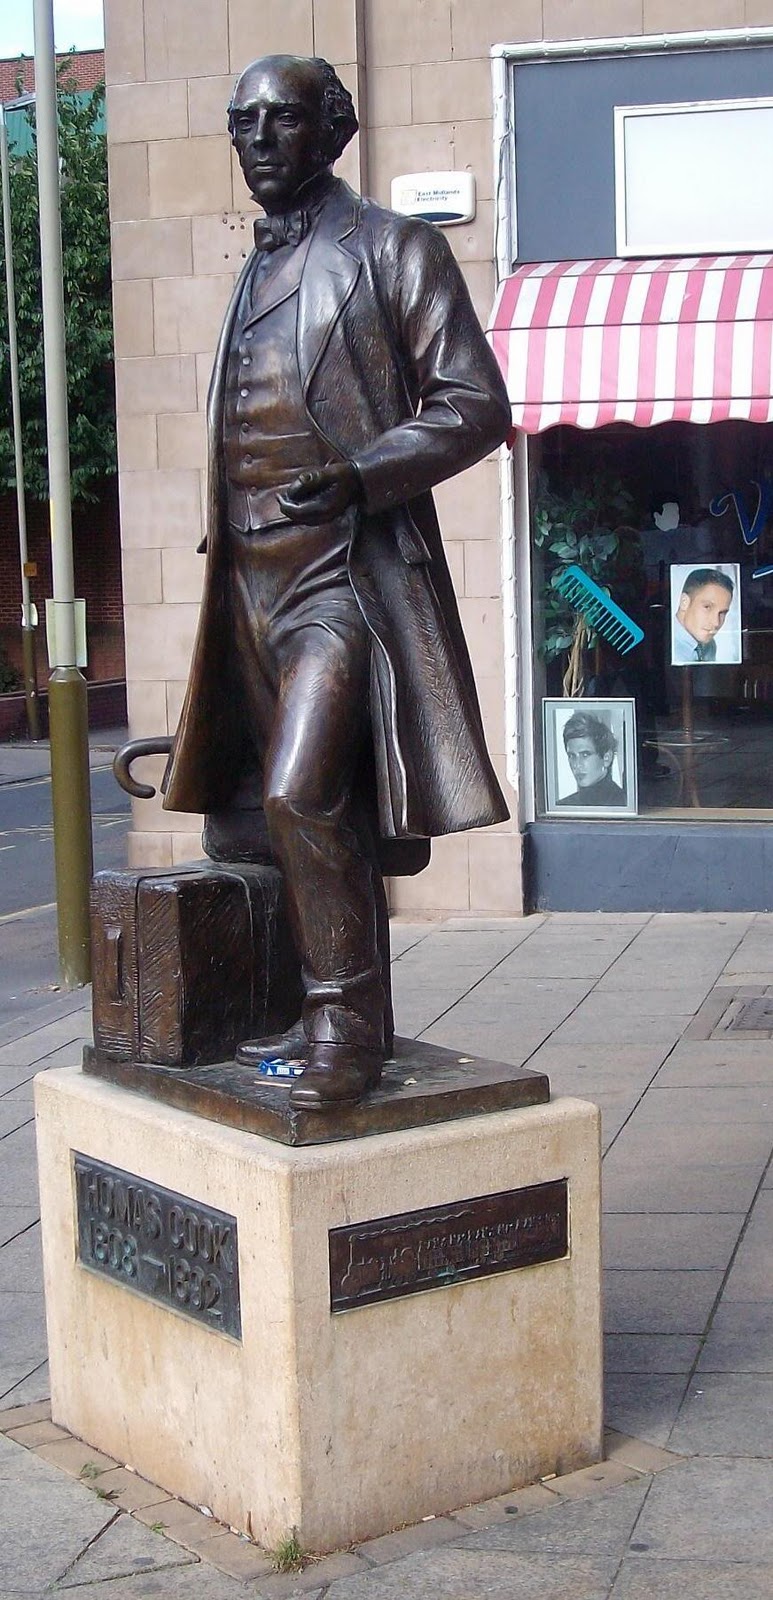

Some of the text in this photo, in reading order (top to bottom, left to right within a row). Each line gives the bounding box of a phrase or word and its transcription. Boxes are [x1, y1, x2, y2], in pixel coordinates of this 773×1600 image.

[75, 1163, 234, 1275] THOMAS COOK
[89, 1217, 138, 1278] 1808
